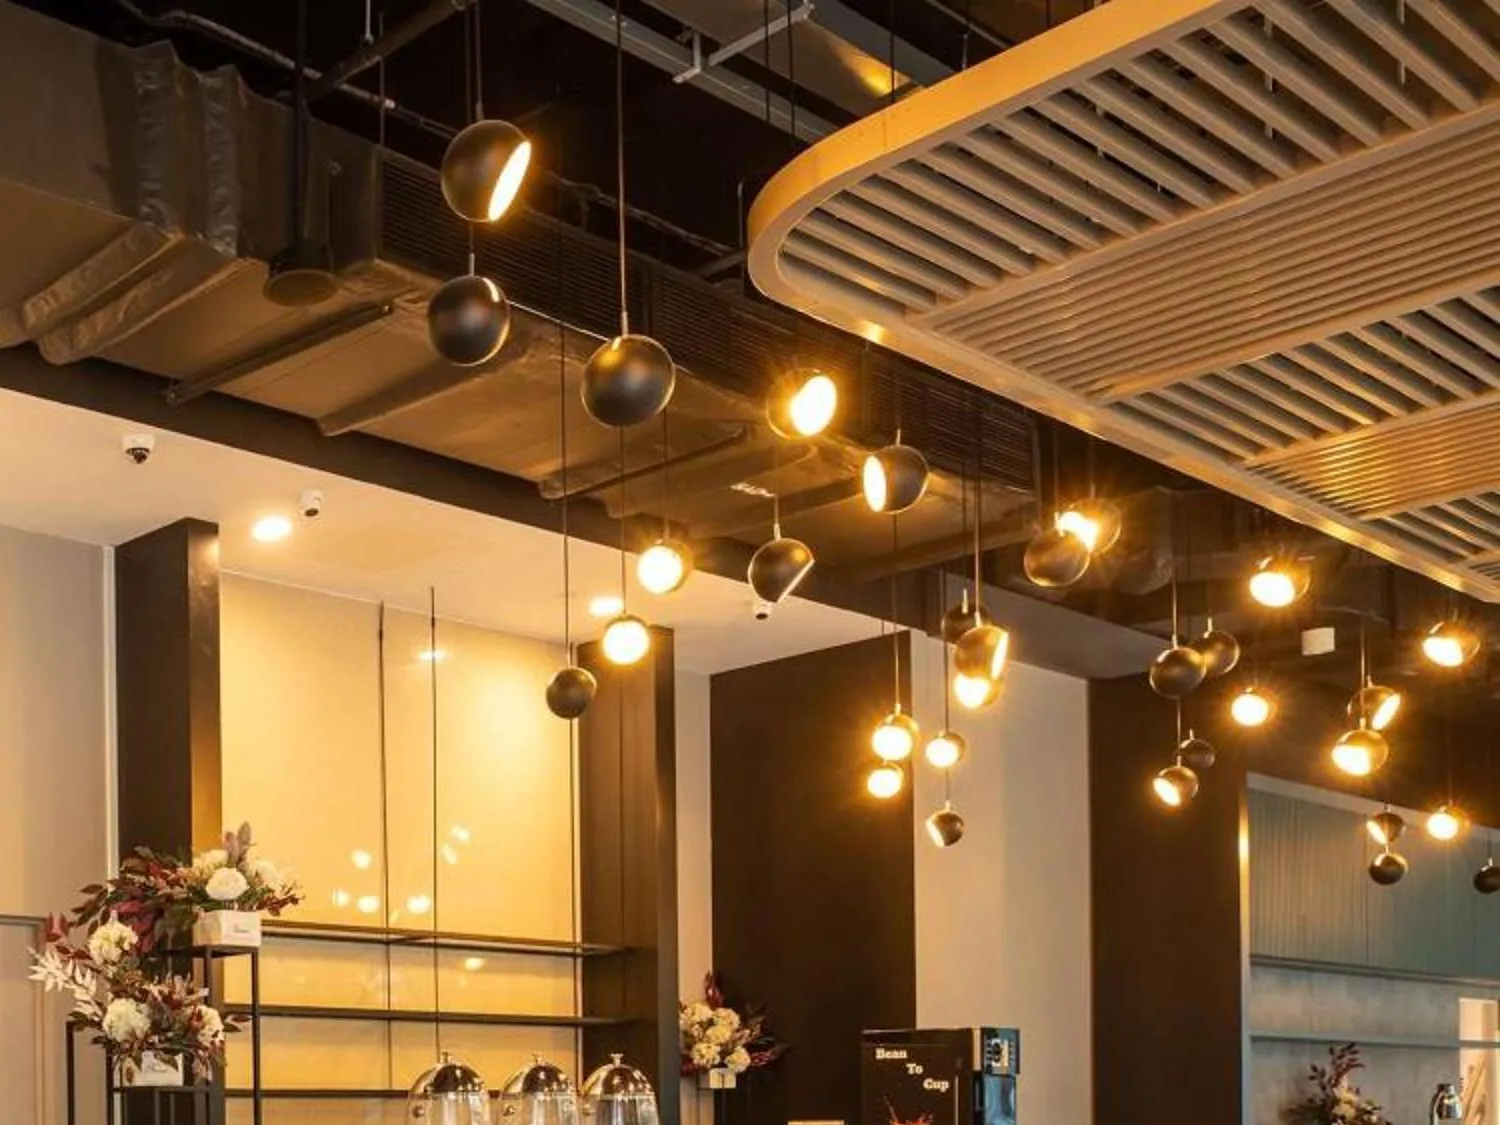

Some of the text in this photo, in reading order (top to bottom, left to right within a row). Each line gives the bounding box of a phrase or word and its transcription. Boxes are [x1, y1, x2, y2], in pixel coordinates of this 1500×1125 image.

[875, 1047, 908, 1060] Bean
[906, 1063, 924, 1075] To
[923, 1077, 949, 1093] Cup
